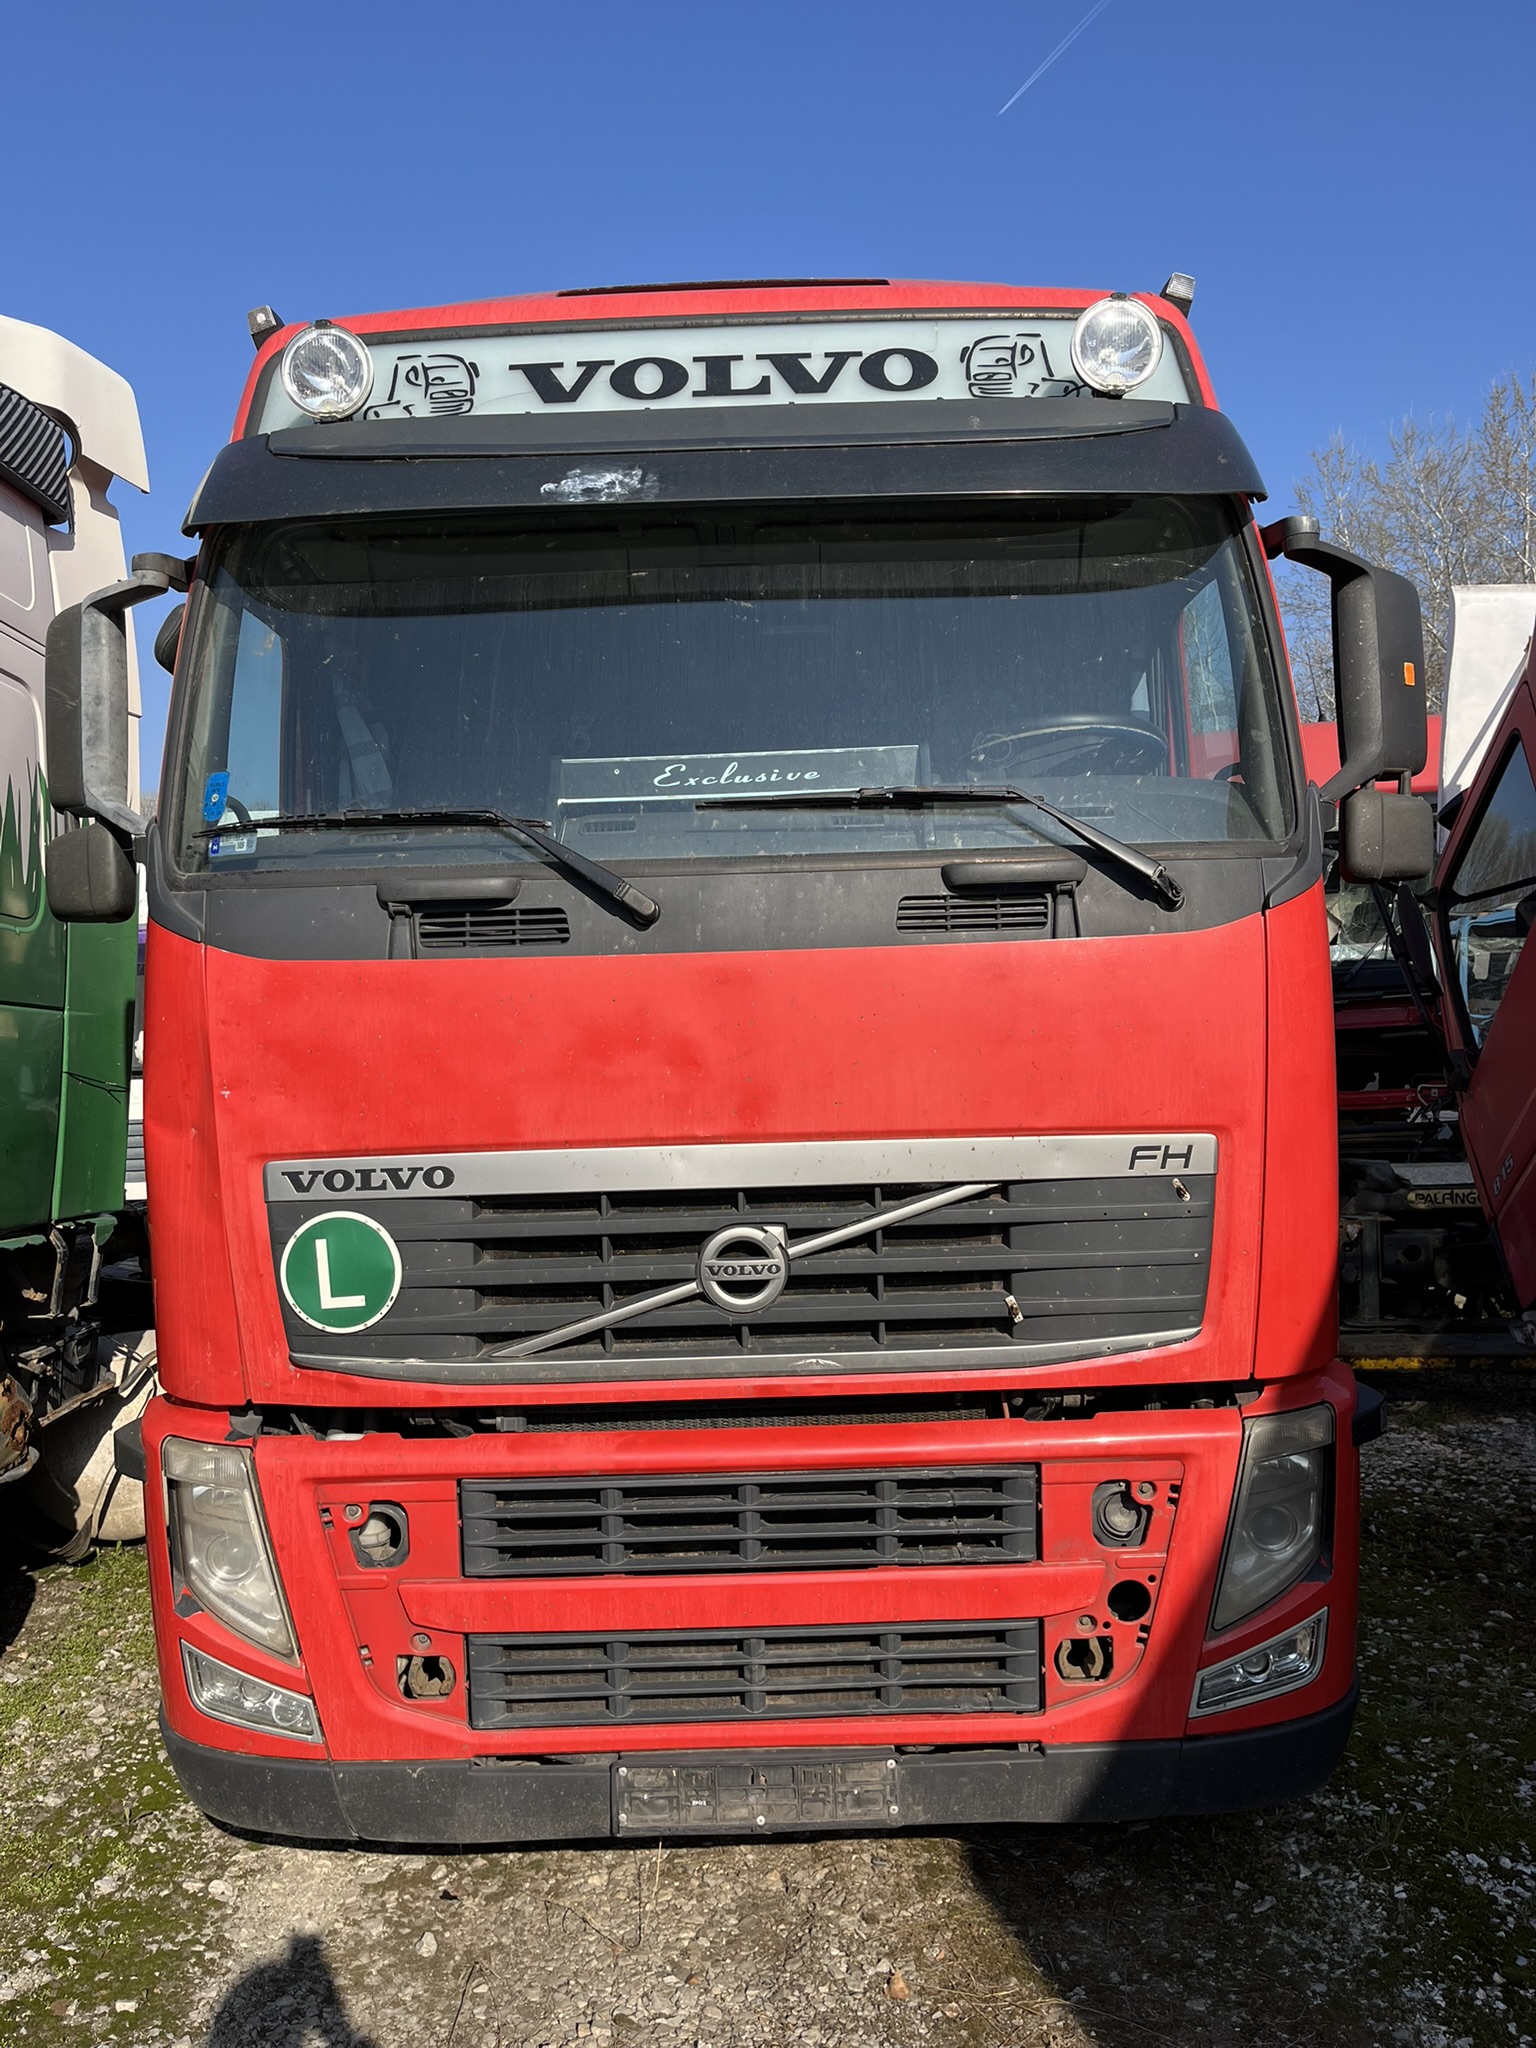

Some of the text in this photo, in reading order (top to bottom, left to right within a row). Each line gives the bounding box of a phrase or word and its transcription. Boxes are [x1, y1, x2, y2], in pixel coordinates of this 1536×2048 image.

[508, 347, 940, 404] VOLVO
[653, 762, 821, 787] Exclusive
[1128, 1144, 1193, 1170] FH
[281, 1165, 455, 1193] VOLVO
[1414, 1192, 1480, 1205] PALFING
[315, 1238, 366, 1310] L
[704, 1264, 781, 1276] VOLVO
